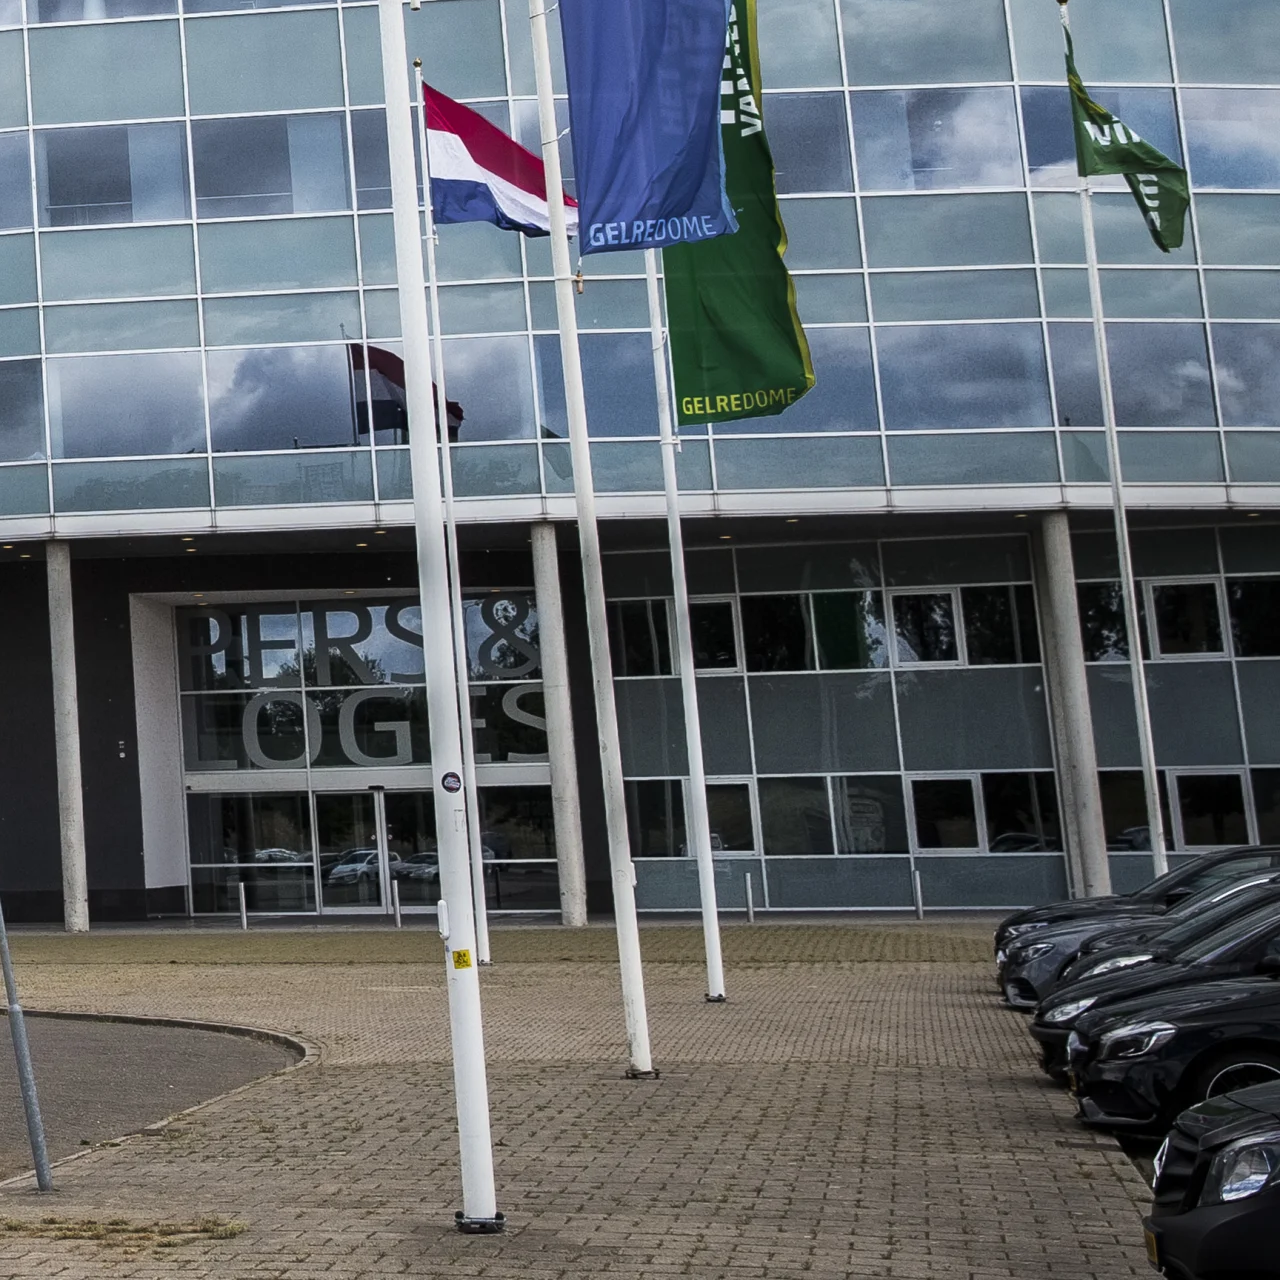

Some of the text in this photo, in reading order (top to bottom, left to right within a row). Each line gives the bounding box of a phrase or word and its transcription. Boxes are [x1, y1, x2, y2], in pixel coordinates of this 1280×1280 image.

[589, 215, 717, 246] GELREDOME
[682, 387, 797, 415] GELREDOME
[179, 593, 543, 688] PERS &
